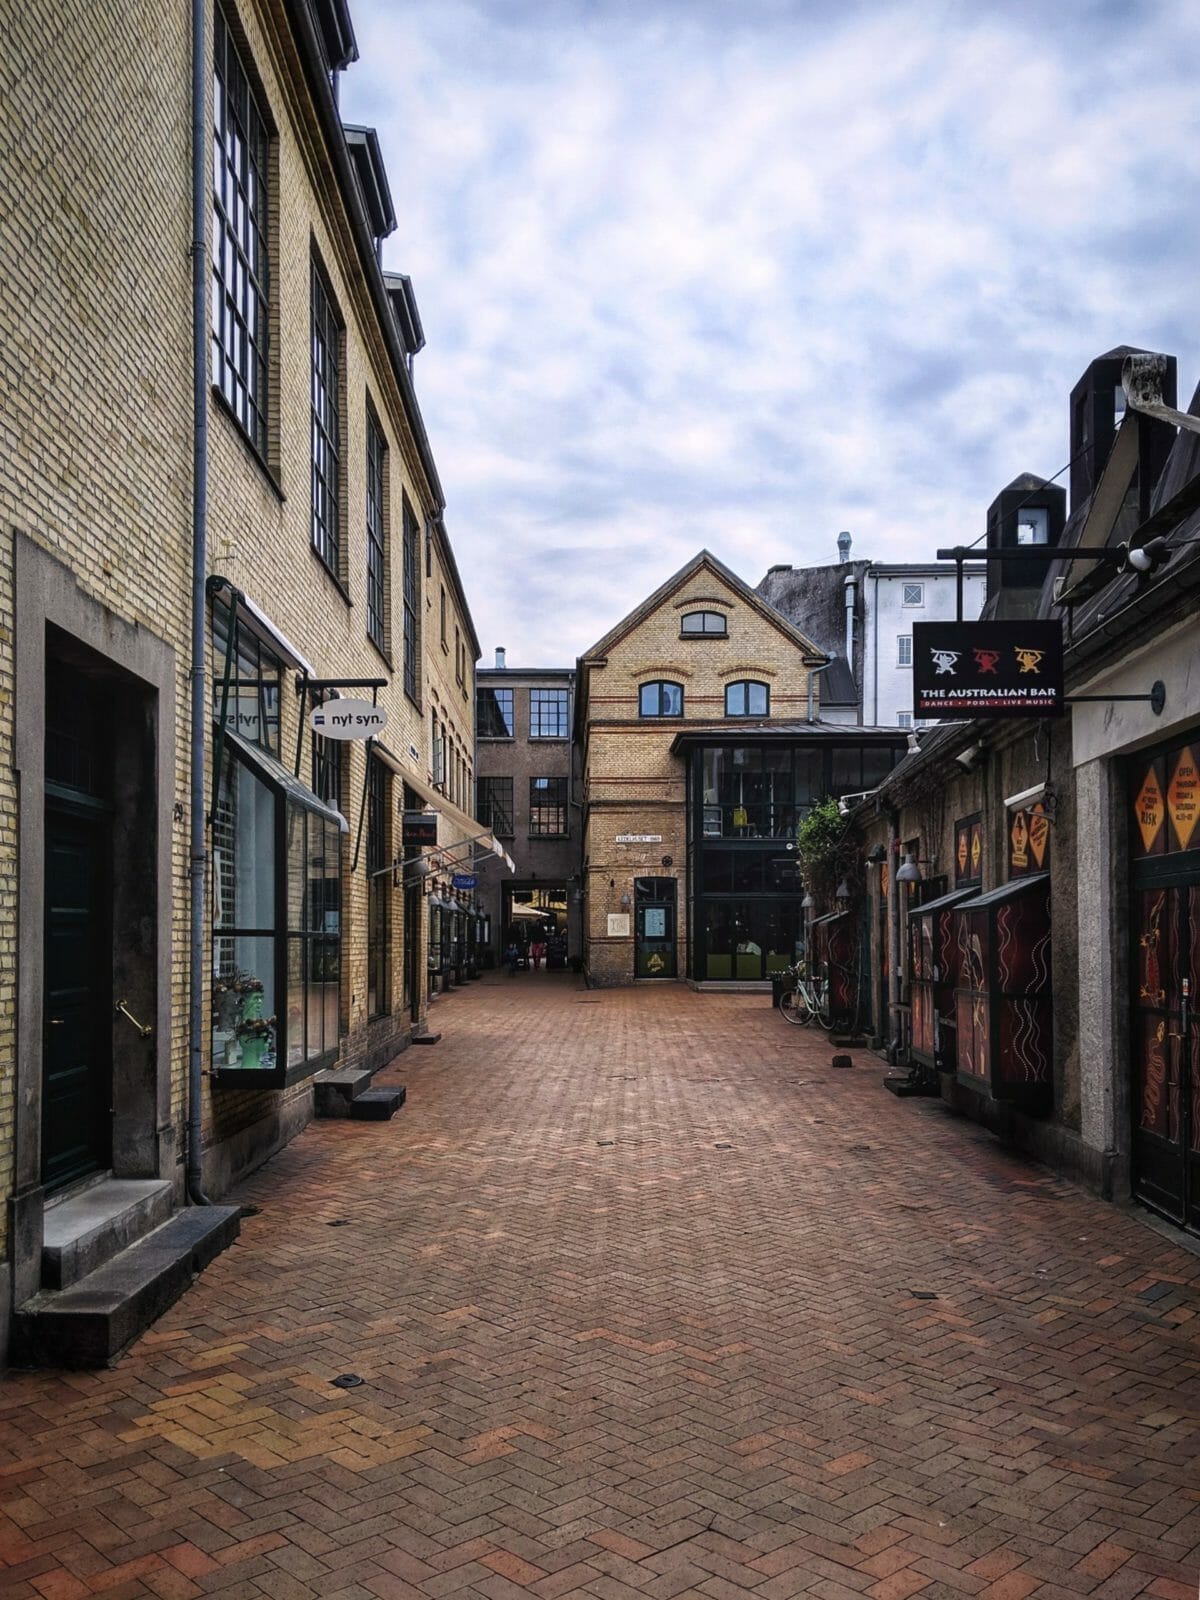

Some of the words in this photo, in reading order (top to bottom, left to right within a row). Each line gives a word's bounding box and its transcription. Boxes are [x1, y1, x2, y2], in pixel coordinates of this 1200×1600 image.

[920, 689, 945, 698] THE
[948, 688, 1027, 697] AUSTRALIAN
[1030, 688, 1056, 696] BAR
[331, 713, 353, 727] nyt
[356, 714, 383, 727] syn.
[1178, 767, 1193, 776] OPEN
[1176, 802, 1196, 810] SATURDAY
[1141, 810, 1157, 826] RISK
